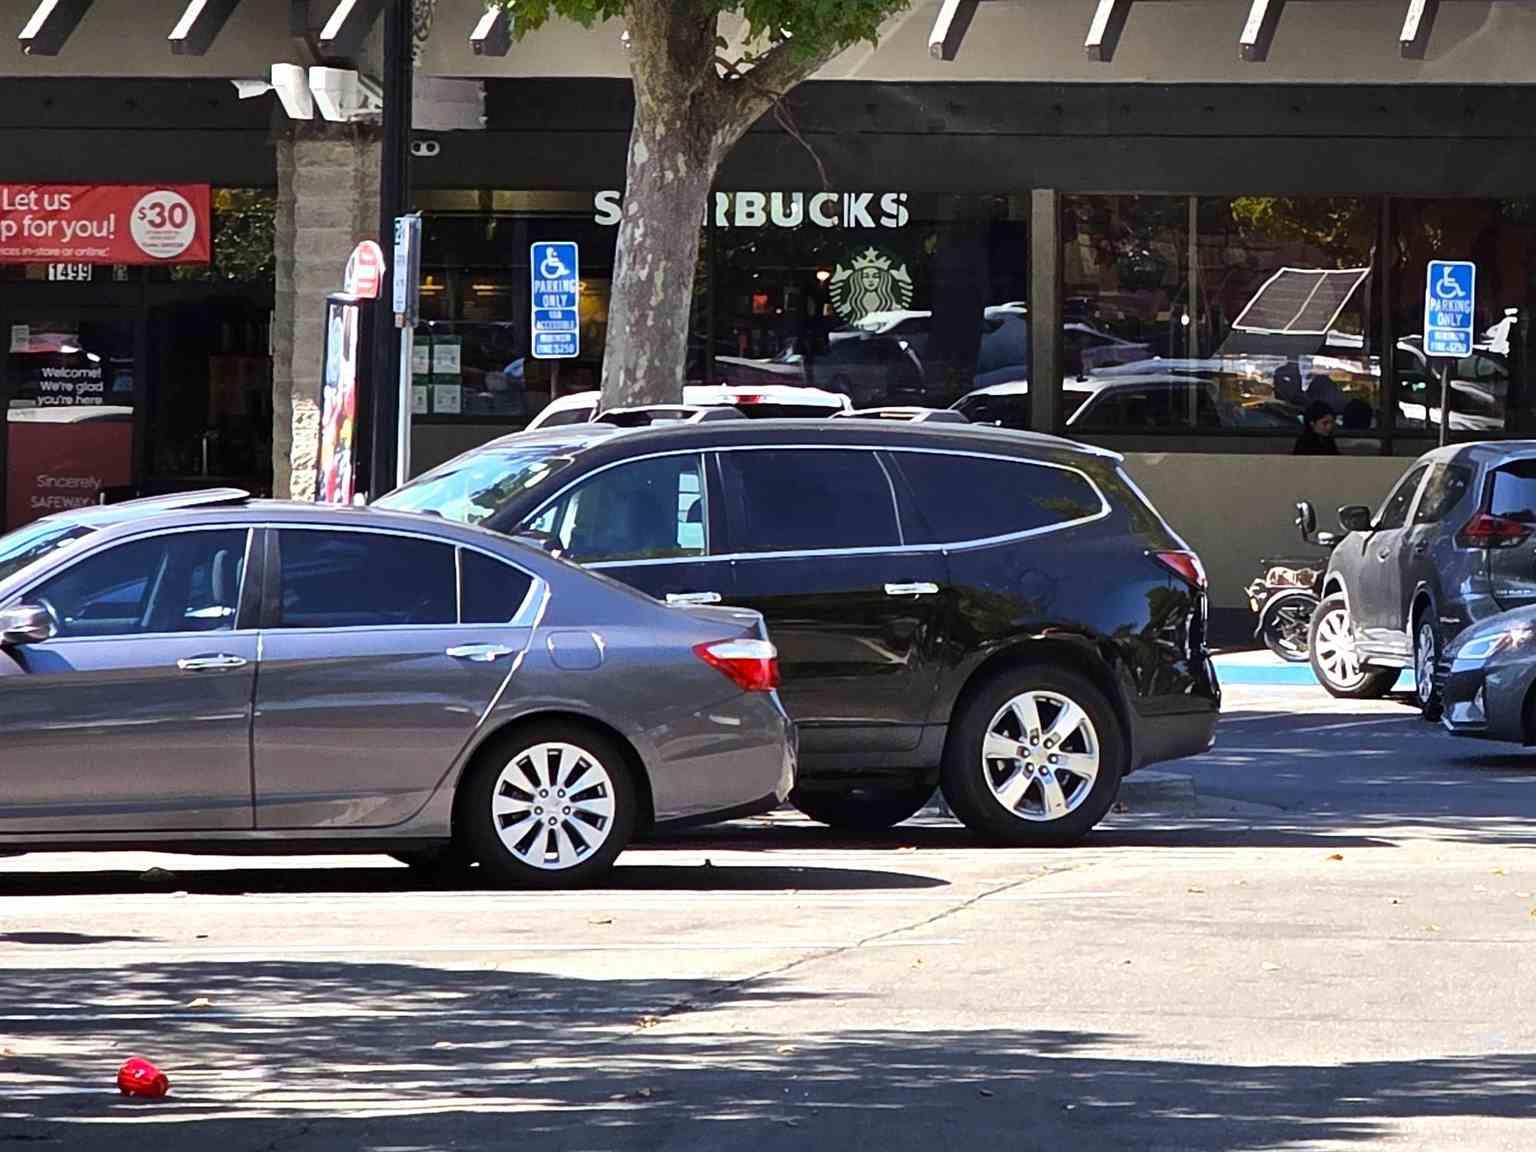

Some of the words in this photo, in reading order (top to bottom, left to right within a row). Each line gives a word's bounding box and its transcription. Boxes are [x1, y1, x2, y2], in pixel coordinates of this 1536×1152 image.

[3, 188, 38, 211] Let
[44, 193, 71, 211] us
[137, 201, 188, 229] $30
[593, 190, 909, 228] SRBUCKS
[23, 215, 57, 238] for
[61, 213, 115, 243] you!
[535, 279, 577, 294] PARKING
[542, 294, 568, 308] ONLY
[1429, 298, 1470, 314] PARKING
[1437, 312, 1462, 327] ONLY
[41, 368, 102, 378] Welcome!
[40, 381, 74, 391] We're
[75, 381, 103, 394] glad
[37, 395, 73, 406] you're
[36, 474, 102, 489] Sincerely
[31, 496, 91, 509] SAFEWAY
